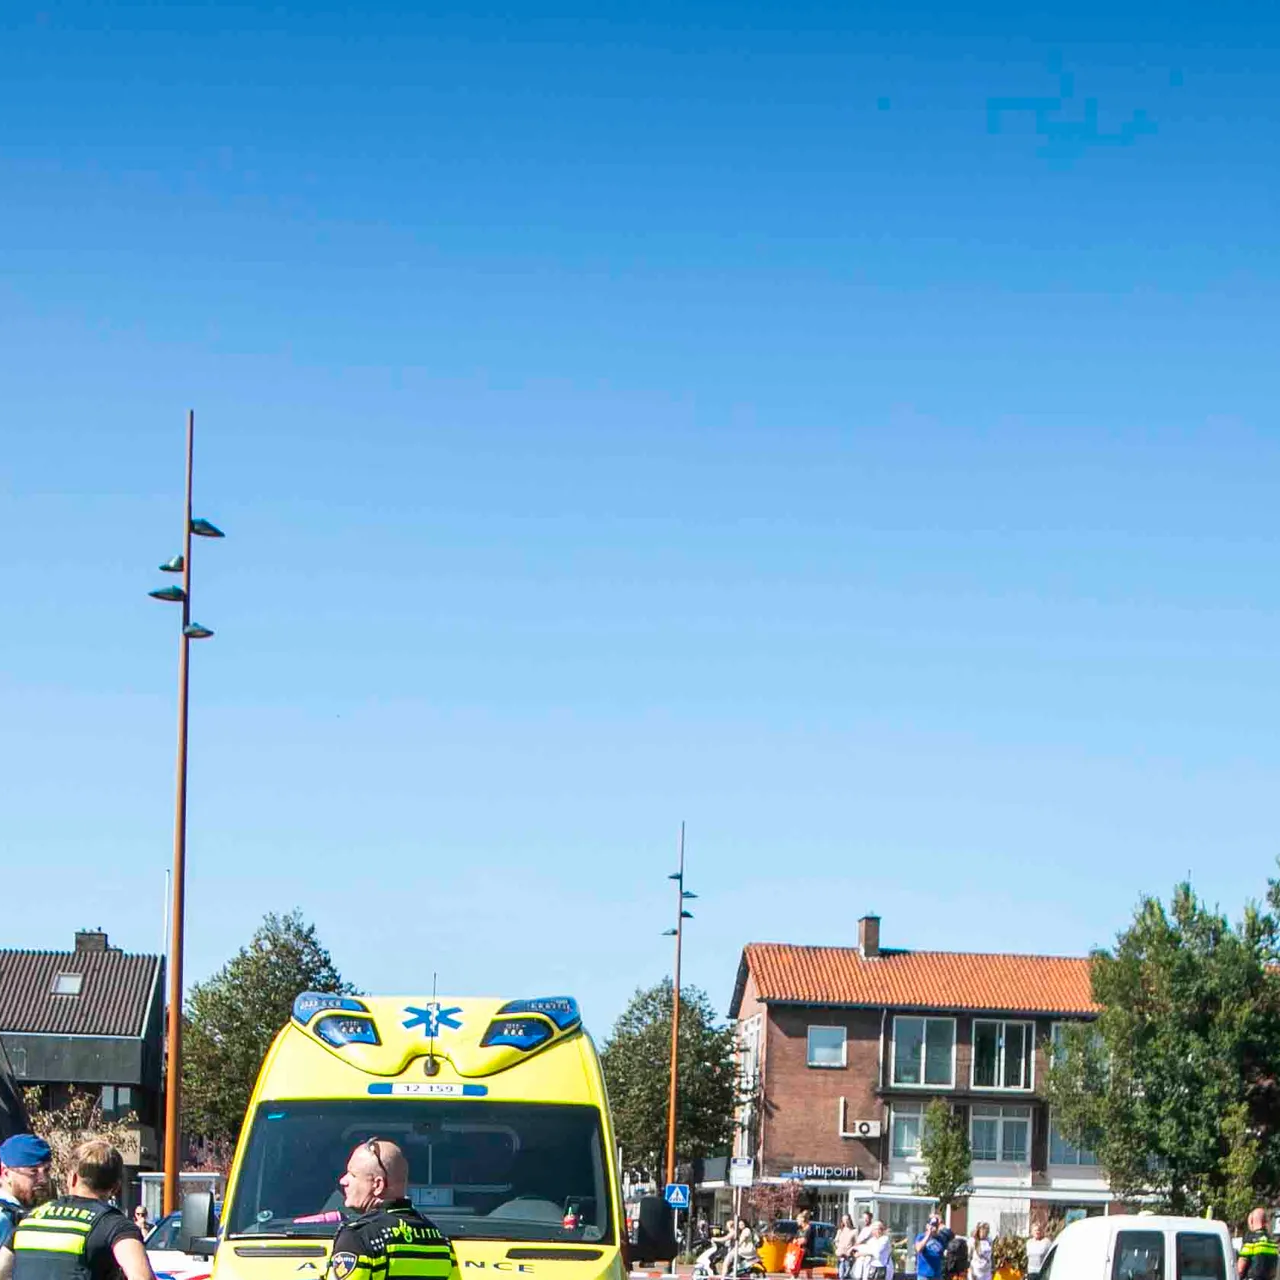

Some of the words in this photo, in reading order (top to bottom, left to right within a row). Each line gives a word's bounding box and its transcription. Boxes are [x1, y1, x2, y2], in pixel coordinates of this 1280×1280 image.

[404, 1084, 421, 1092] 12
[429, 1085, 454, 1093] 159
[791, 1164, 858, 1179] sushipoint
